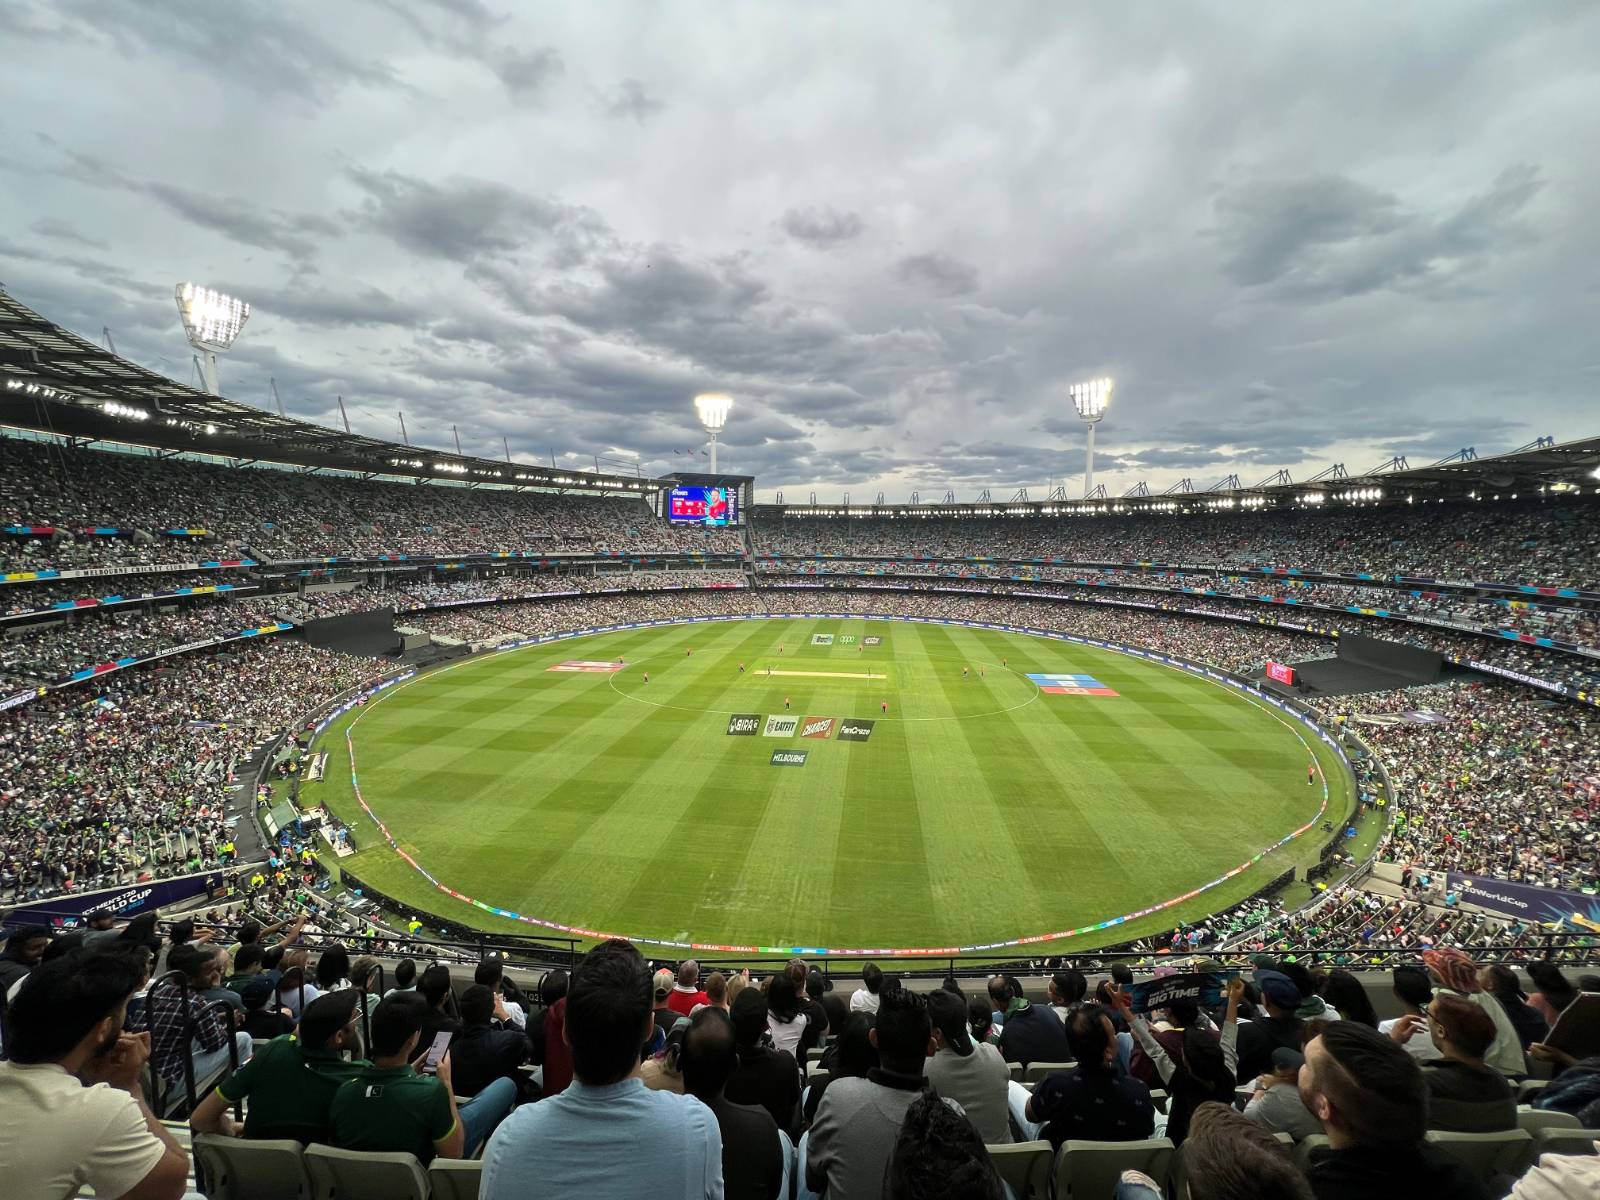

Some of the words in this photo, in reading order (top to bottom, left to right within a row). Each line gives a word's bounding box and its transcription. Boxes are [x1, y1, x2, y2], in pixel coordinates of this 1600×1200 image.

[84, 567, 128, 576] MELBOURNE
[131, 565, 163, 573] CRICKET
[1493, 665, 1502, 674] T20
[1502, 668, 1519, 679] WORLD
[1519, 674, 1530, 682] CUP
[1529, 676, 1557, 690] AUSTRALIA
[774, 721, 796, 732] EATFIT
[802, 719, 832, 736] CHARGED
[840, 726, 870, 736] FanCraze
[772, 753, 806, 763] MELBOURNE
[82, 907, 95, 916] ICC
[96, 895, 122, 911] MEN'S
[122, 889, 137, 899] T20
[105, 900, 128, 912] RLD
[129, 888, 152, 903] CUP
[1147, 992, 1168, 1007] BIG
[1168, 987, 1200, 999] TIME
